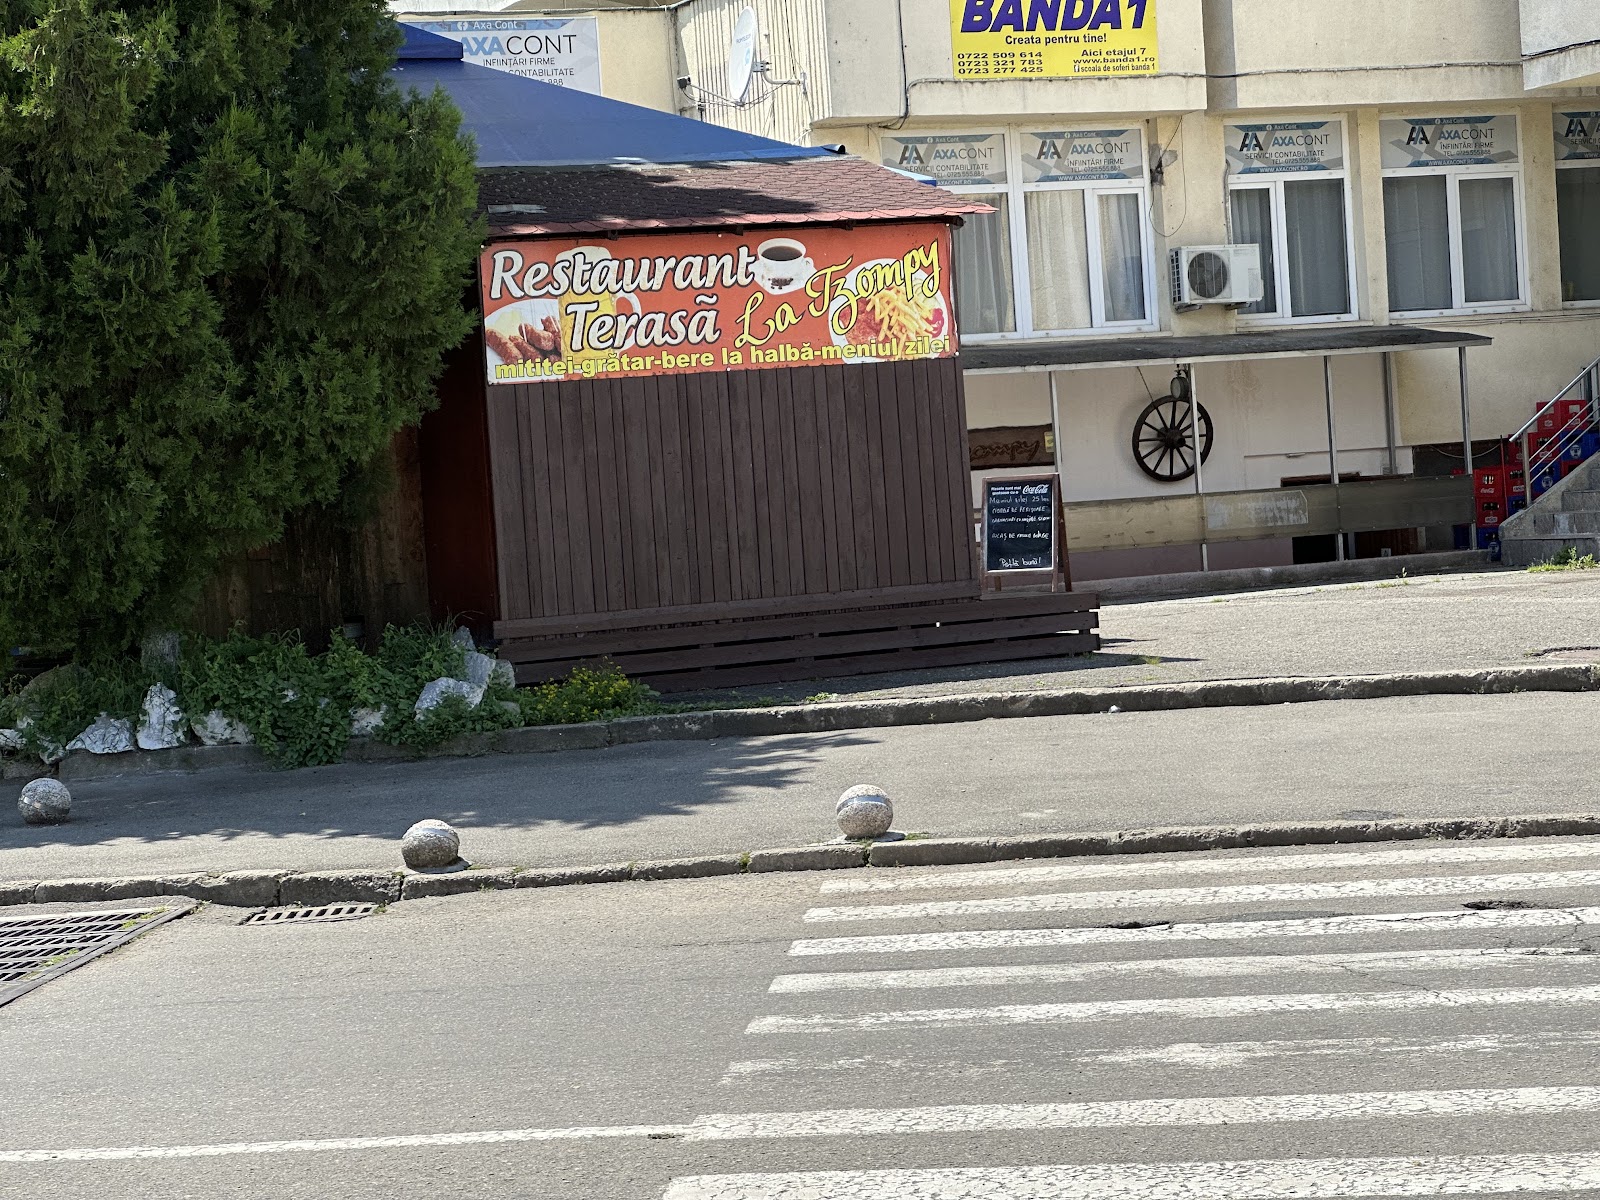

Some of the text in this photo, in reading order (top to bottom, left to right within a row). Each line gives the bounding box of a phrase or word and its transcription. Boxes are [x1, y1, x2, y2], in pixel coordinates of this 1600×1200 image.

[961, 0, 1147, 32] BANDA1
[473, 20, 517, 29] Axa Cont
[461, 35, 576, 56] AXACONT
[1005, 33, 1107, 46] Creata pentru tine!
[1106, 48, 1136, 57] etajul
[530, 57, 555, 65] FIRME
[1073, 56, 1155, 64] www.banda1.ro
[1131, 63, 1150, 71] banda
[1440, 128, 1495, 140] AXACONT
[1272, 134, 1330, 147] AXACONT
[1570, 137, 1597, 145] SERVICII
[933, 148, 994, 160] AXACONT
[1071, 142, 1130, 154] AXACONT
[1274, 150, 1325, 158] CONTABILITATE
[936, 163, 989, 171] CONTABILITATE
[490, 245, 757, 300] Restaurant
[734, 290, 805, 349] La
[495, 335, 950, 379] mititei-grătar-bere la halbă-meniul zilei
